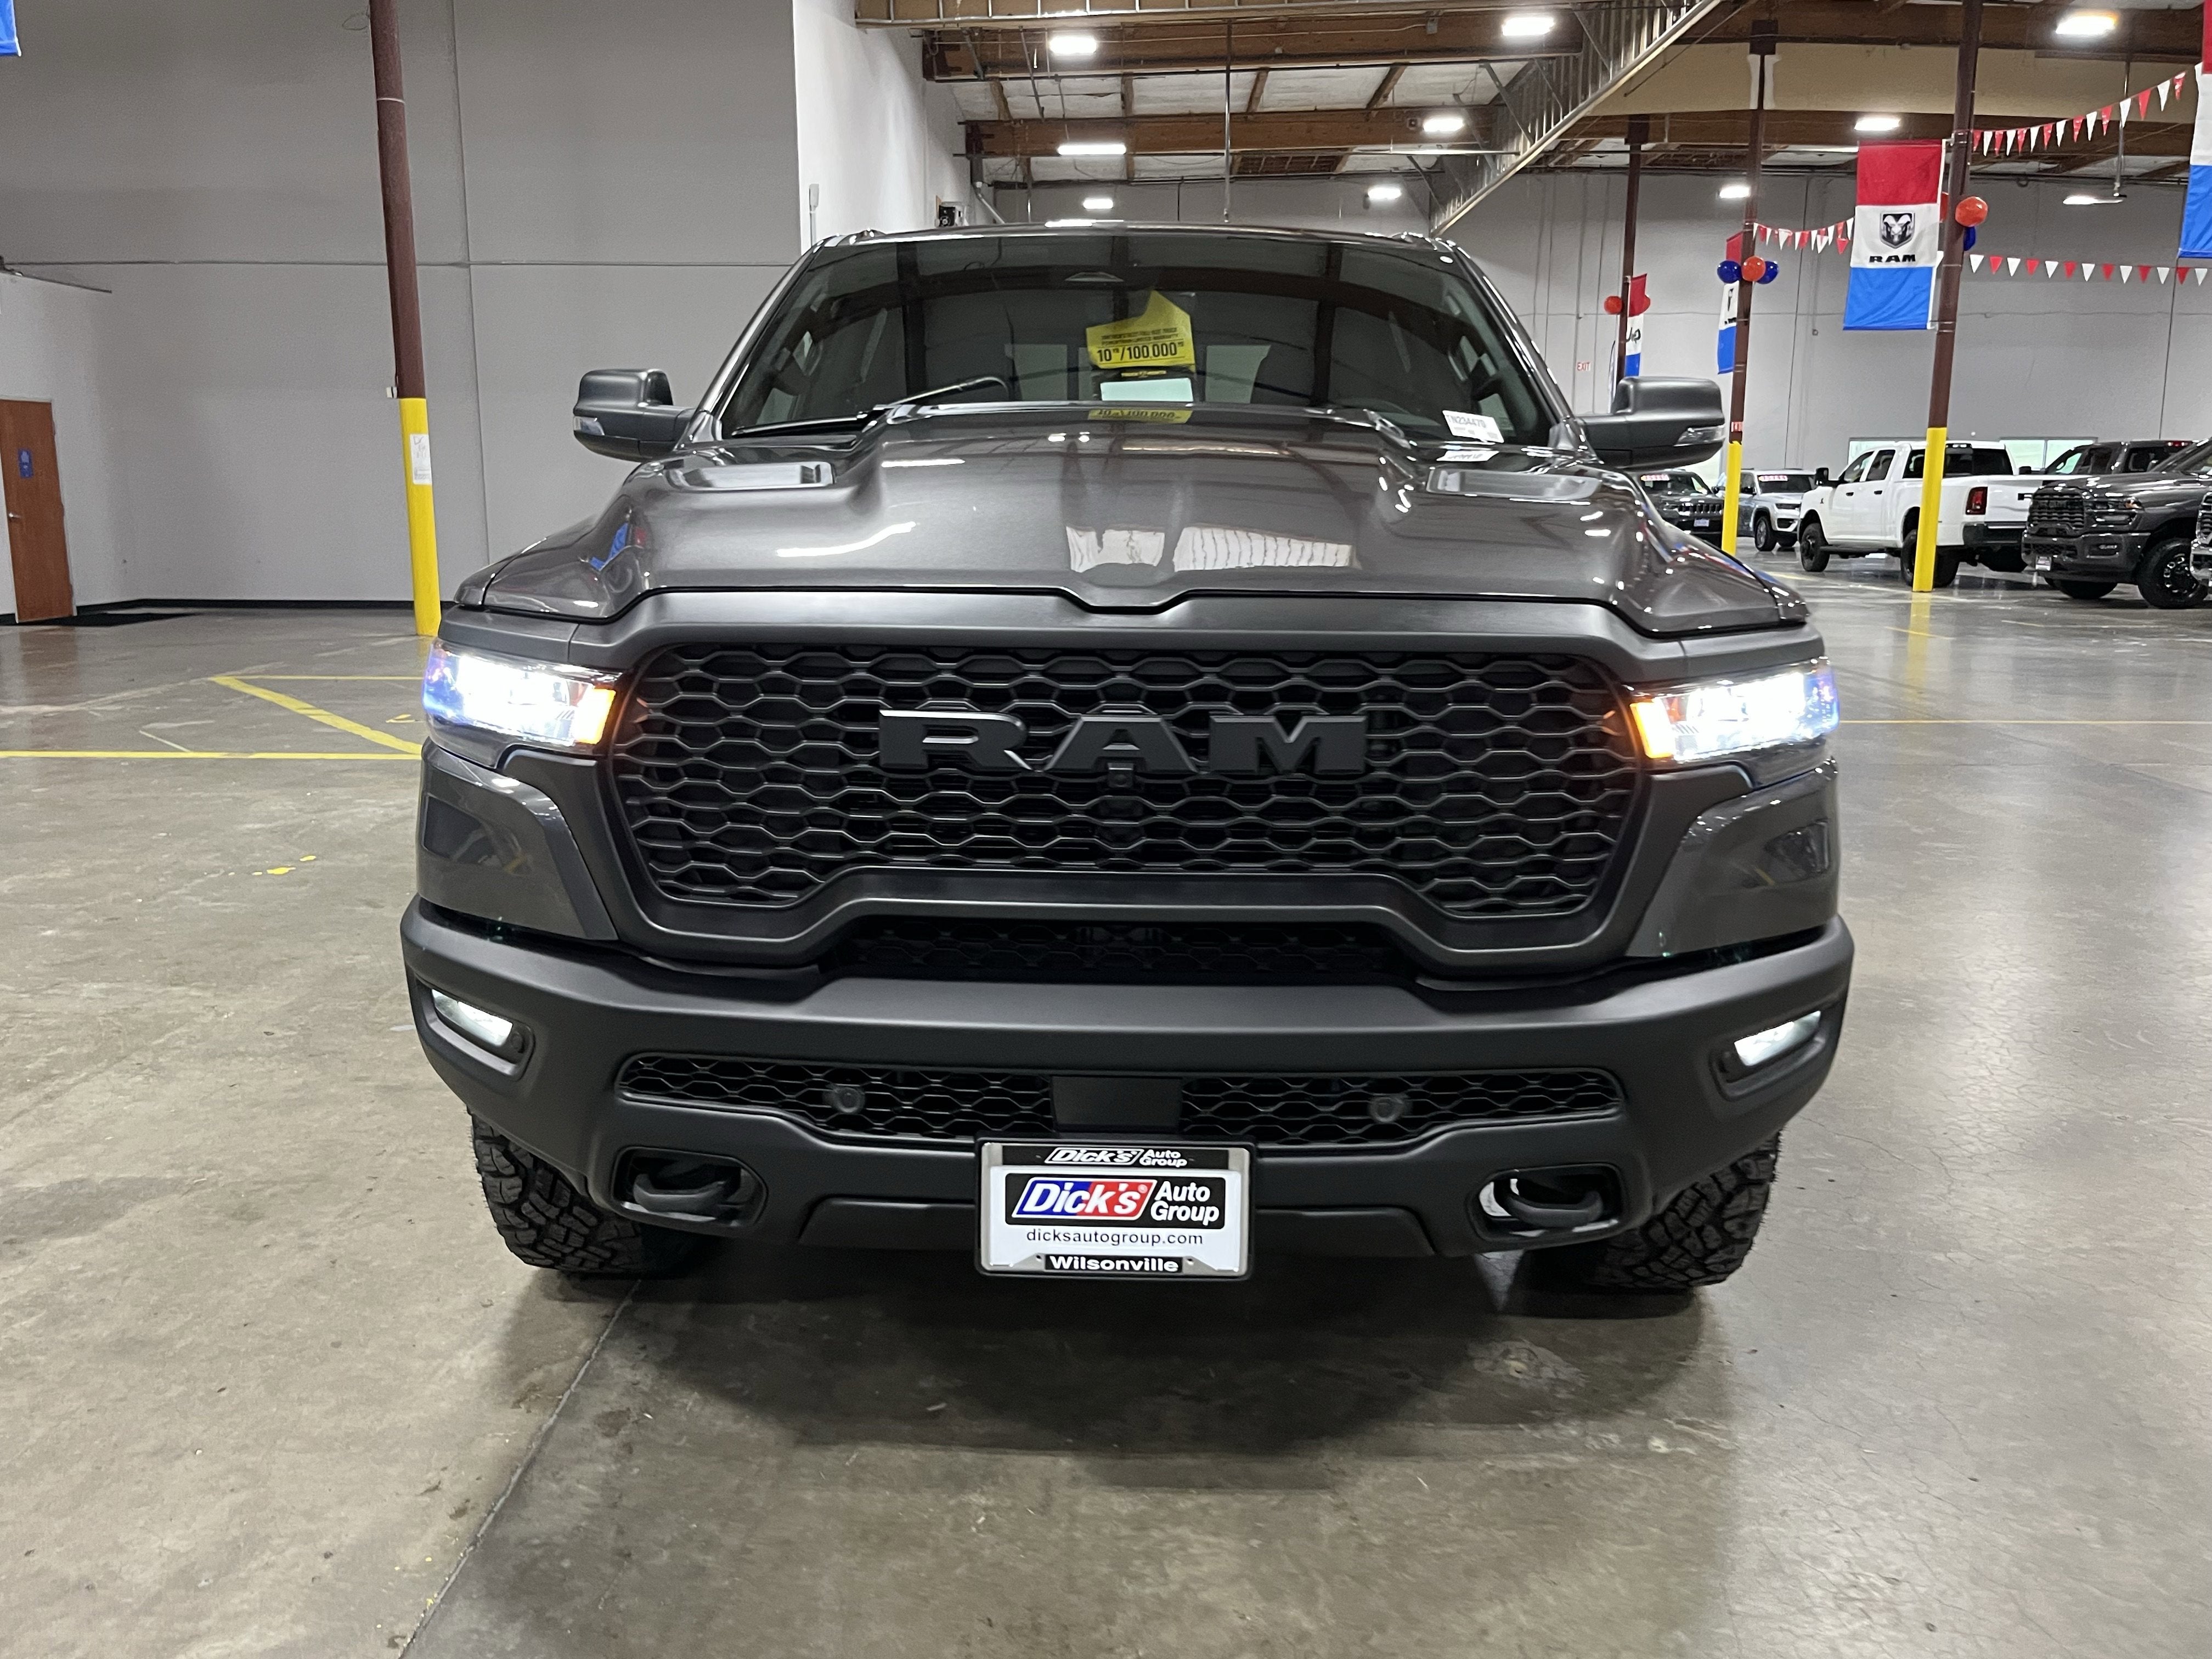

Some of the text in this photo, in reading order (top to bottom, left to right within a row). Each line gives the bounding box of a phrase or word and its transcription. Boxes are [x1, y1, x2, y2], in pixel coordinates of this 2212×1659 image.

[1869, 254, 1916, 263] RAM
[1577, 362, 1590, 371] EXIT
[879, 709, 1367, 774] RAM
[1052, 1149, 1181, 1163] Dick's Auto
[1139, 1157, 1188, 1167] Group
[1023, 1181, 1210, 1214] Dick's Auto
[1150, 1200, 1220, 1226] Group
[1026, 1229, 1203, 1246] dicksautogroup.com
[1049, 1256, 1179, 1272] Wilsonville
